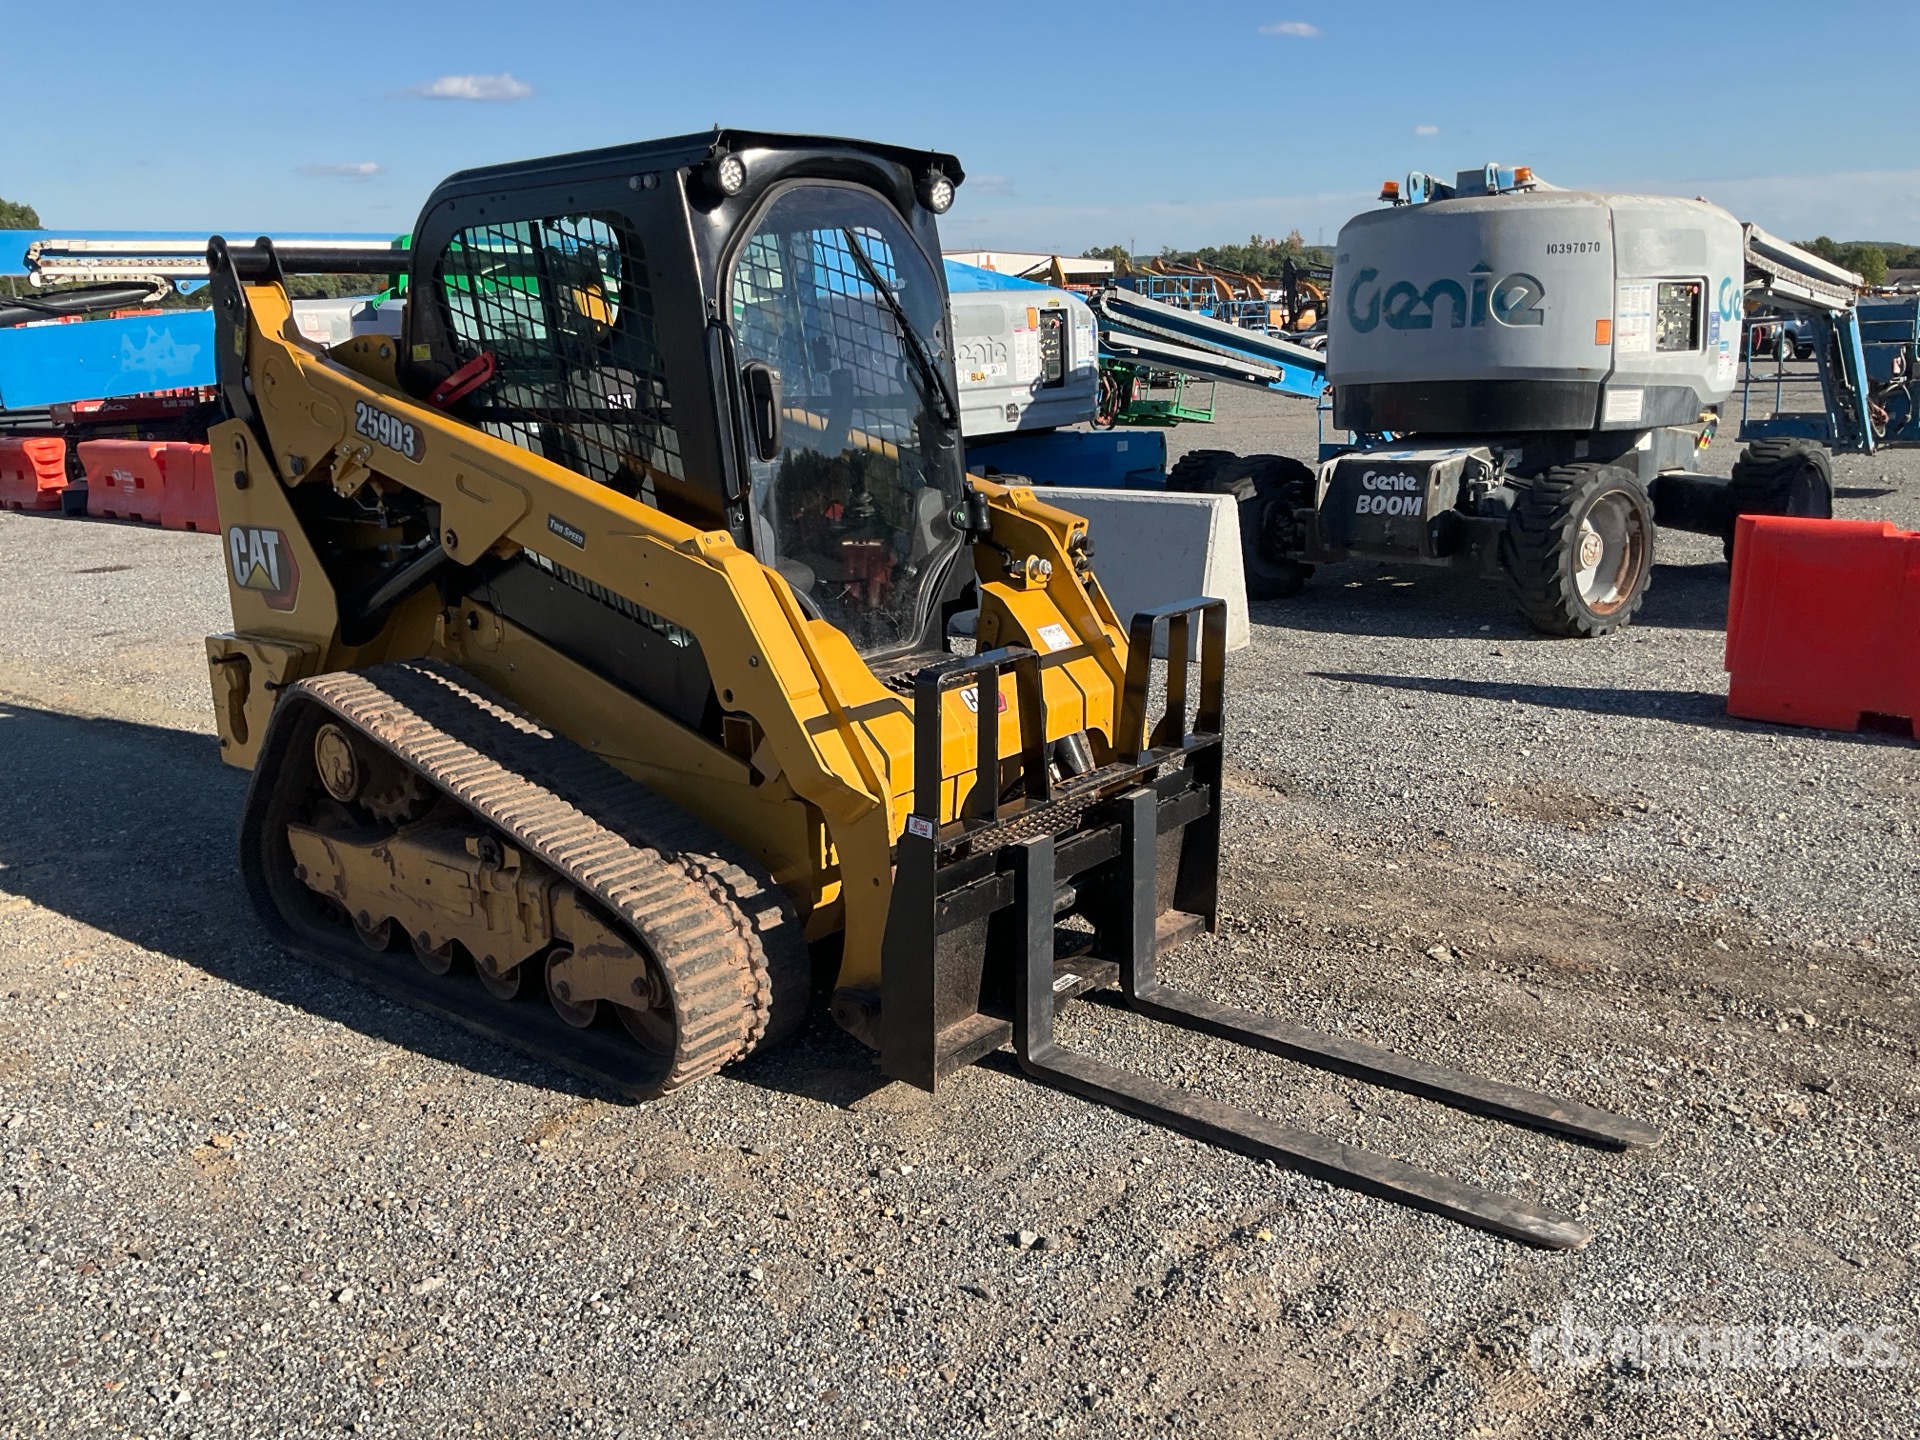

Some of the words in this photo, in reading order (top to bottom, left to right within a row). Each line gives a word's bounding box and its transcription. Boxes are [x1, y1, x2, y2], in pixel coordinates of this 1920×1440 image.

[1547, 241, 1600, 255] 10397070
[1310, 271, 1331, 279] DEERE
[1346, 260, 1546, 333] Genie
[970, 372, 986, 382] BLA
[355, 402, 416, 457] 259D3
[1362, 470, 1417, 491] Genie
[1355, 494, 1423, 516] BOOM
[229, 527, 281, 591] CAT
